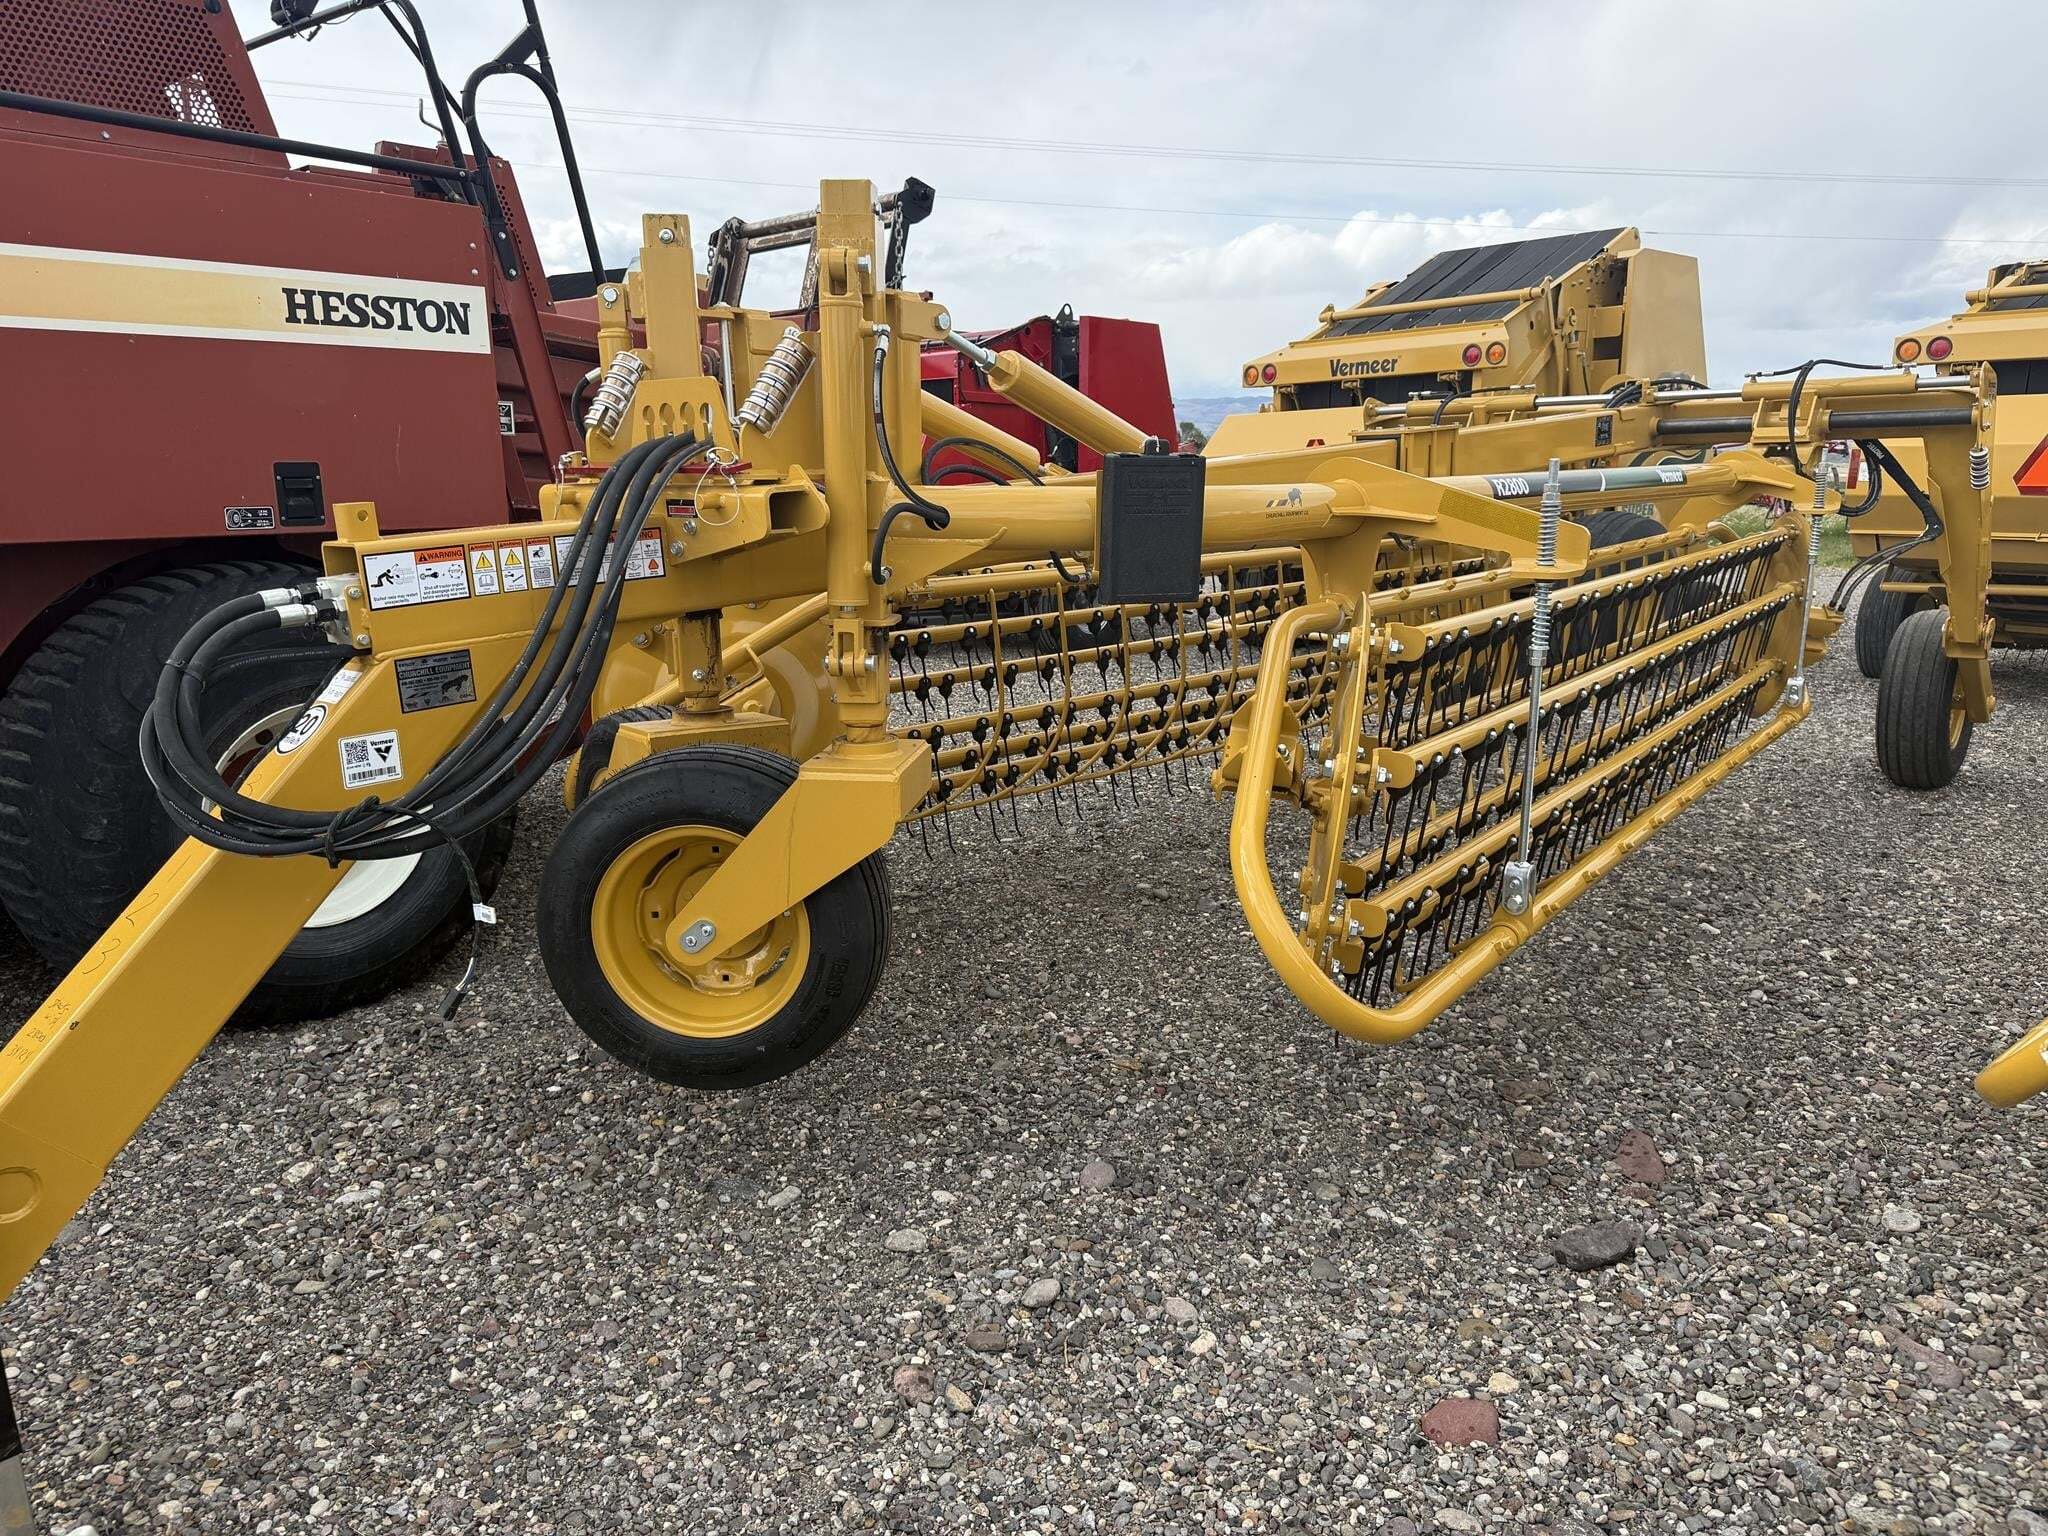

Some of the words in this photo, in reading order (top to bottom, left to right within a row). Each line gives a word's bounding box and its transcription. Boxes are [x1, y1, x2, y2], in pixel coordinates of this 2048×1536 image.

[281, 287, 471, 335] HESSTON
[1329, 358, 1399, 378] Vermeer
[1492, 477, 1530, 497] R2800
[1656, 468, 1685, 483] Vermeer
[427, 549, 463, 561] WARNING
[370, 738, 395, 747] Vermeer
